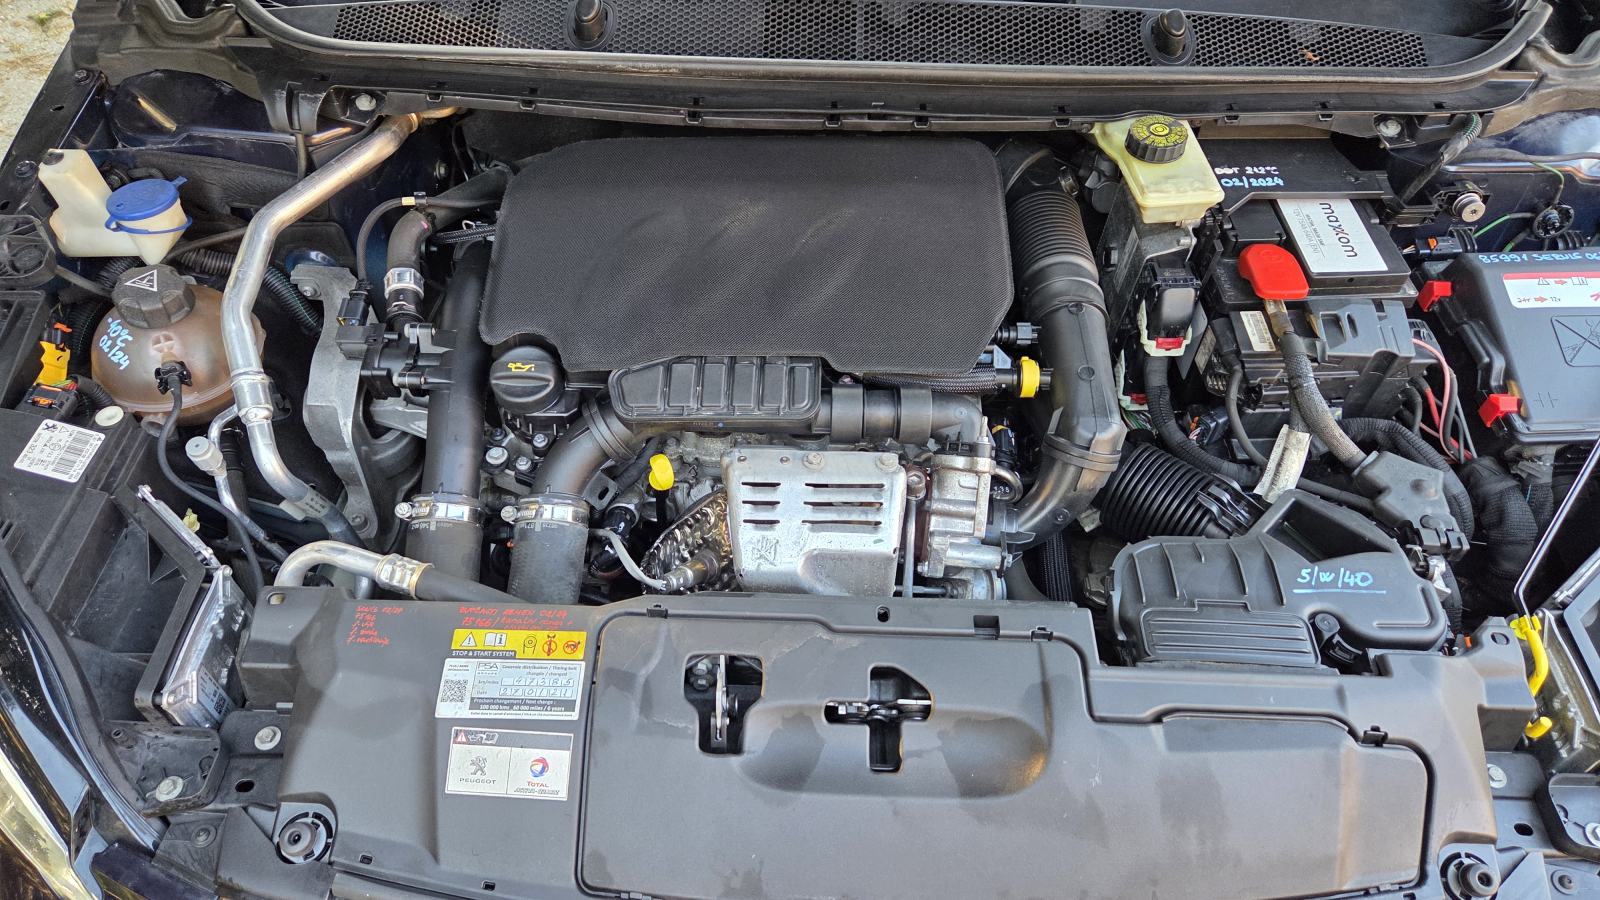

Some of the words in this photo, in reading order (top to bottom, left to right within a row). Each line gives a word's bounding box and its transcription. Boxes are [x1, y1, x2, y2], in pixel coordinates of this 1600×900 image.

[1221, 176, 1284, 188] 02/2024
[1478, 253, 1528, 264] 85991
[99, 335, 130, 370] 02/24
[478, 662, 499, 670] PSA
[459, 777, 497, 785] PEUGEOT
[527, 780, 550, 788] TOTAL
